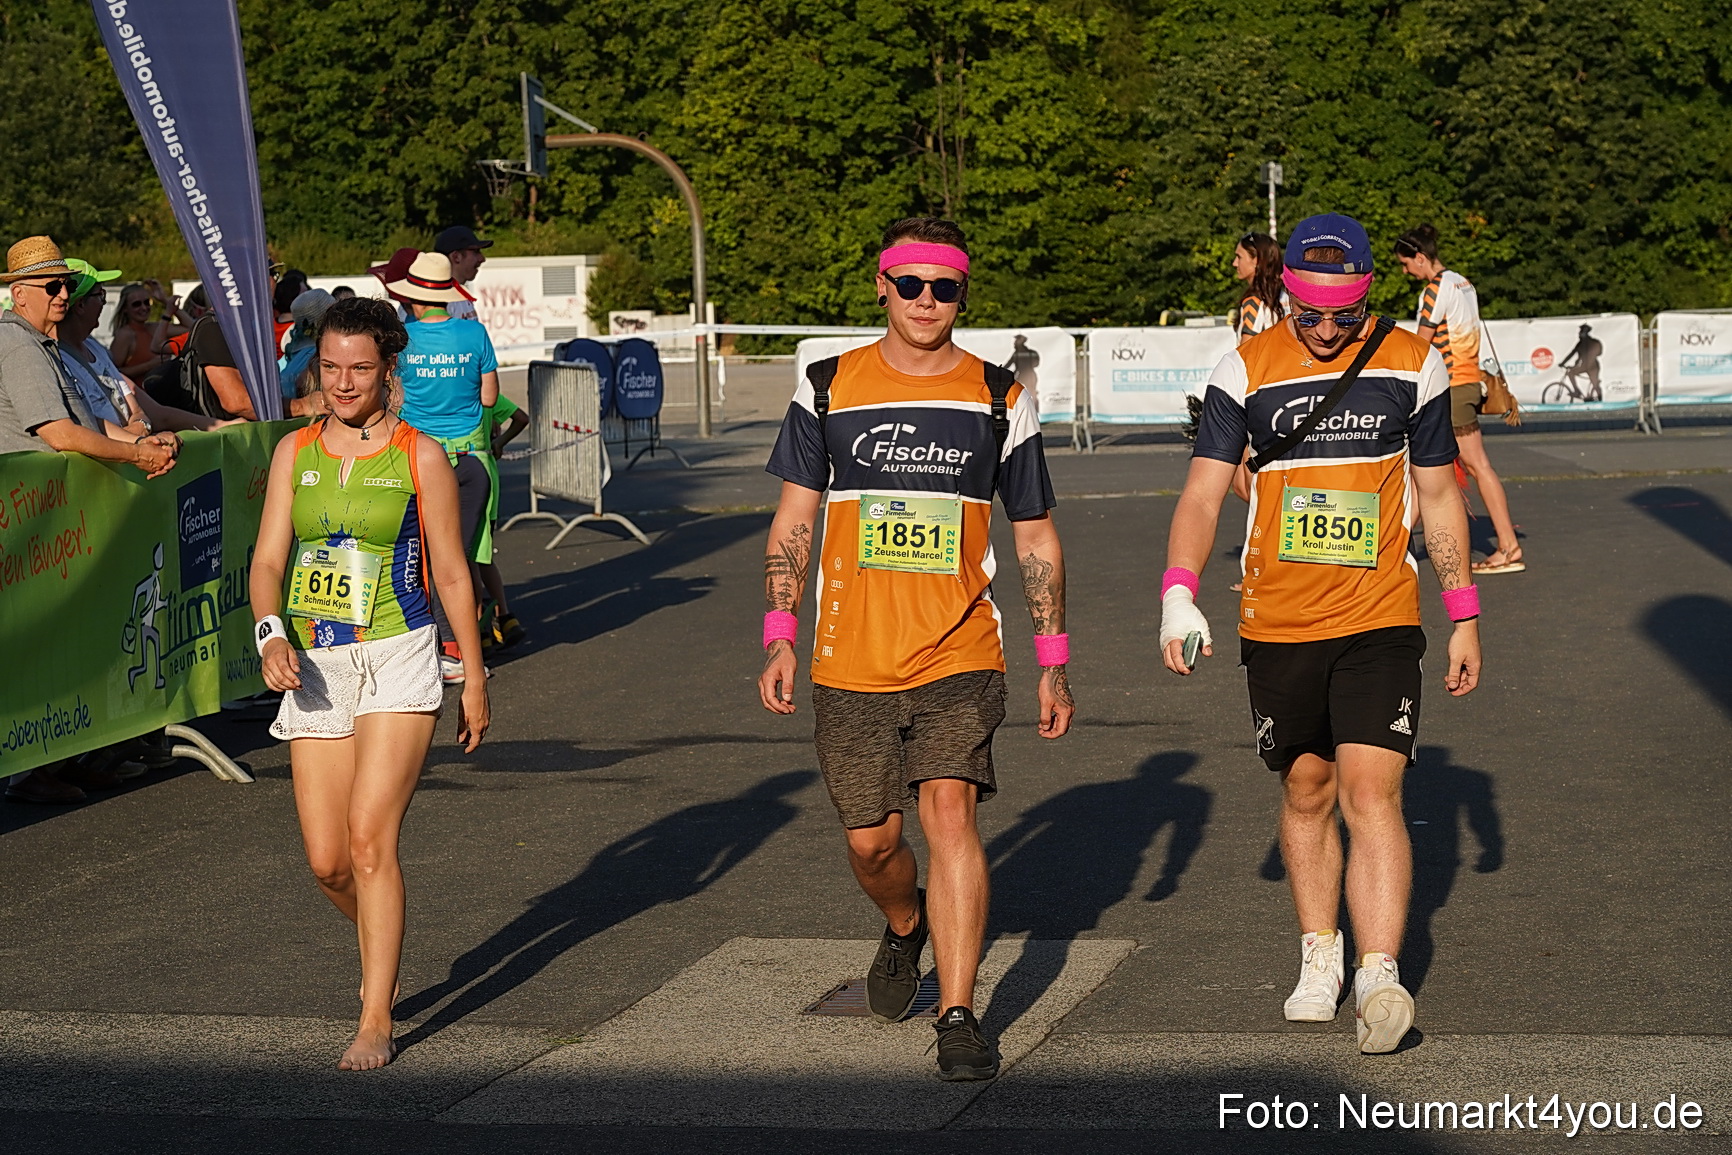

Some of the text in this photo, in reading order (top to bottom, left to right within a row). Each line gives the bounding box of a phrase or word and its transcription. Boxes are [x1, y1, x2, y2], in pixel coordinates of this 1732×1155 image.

[1681, 333, 1715, 346] NOW
[407, 354, 426, 364] Hier
[458, 353, 472, 364] ihr
[1112, 349, 1146, 361] NOW
[440, 367, 458, 378] auf
[623, 371, 657, 389] Fischer
[1114, 371, 1164, 382] E-BIKES
[1167, 371, 1178, 382] &
[1292, 410, 1387, 431] Fscher
[1303, 432, 1380, 443] AUTOMOBILE
[871, 440, 973, 465] Fischer
[880, 463, 963, 477] AUTOMOBILE
[363, 478, 403, 488] BOCK
[9, 479, 68, 525] Firmen
[1306, 502, 1337, 511] Firmenlauf
[185, 507, 221, 535] Fischer
[1297, 513, 1363, 541] 1850
[188, 525, 221, 545] AUTOMOBILE
[864, 523, 874, 559] WALK
[876, 521, 941, 549] 1851
[1285, 515, 1295, 550] WALK
[1364, 522, 1375, 556] 2022
[27, 508, 92, 580] länger!
[874, 546, 943, 560] Zeussel Marcel
[945, 529, 956, 564] 2022
[1302, 539, 1355, 552] Kroll Justin
[292, 571, 304, 605] WALK
[309, 570, 352, 598] 615
[303, 595, 352, 610] Schmid Kyra
[361, 582, 372, 615] 2022
[1398, 696, 1413, 715] JK
[1389, 723, 1413, 736] adidas
